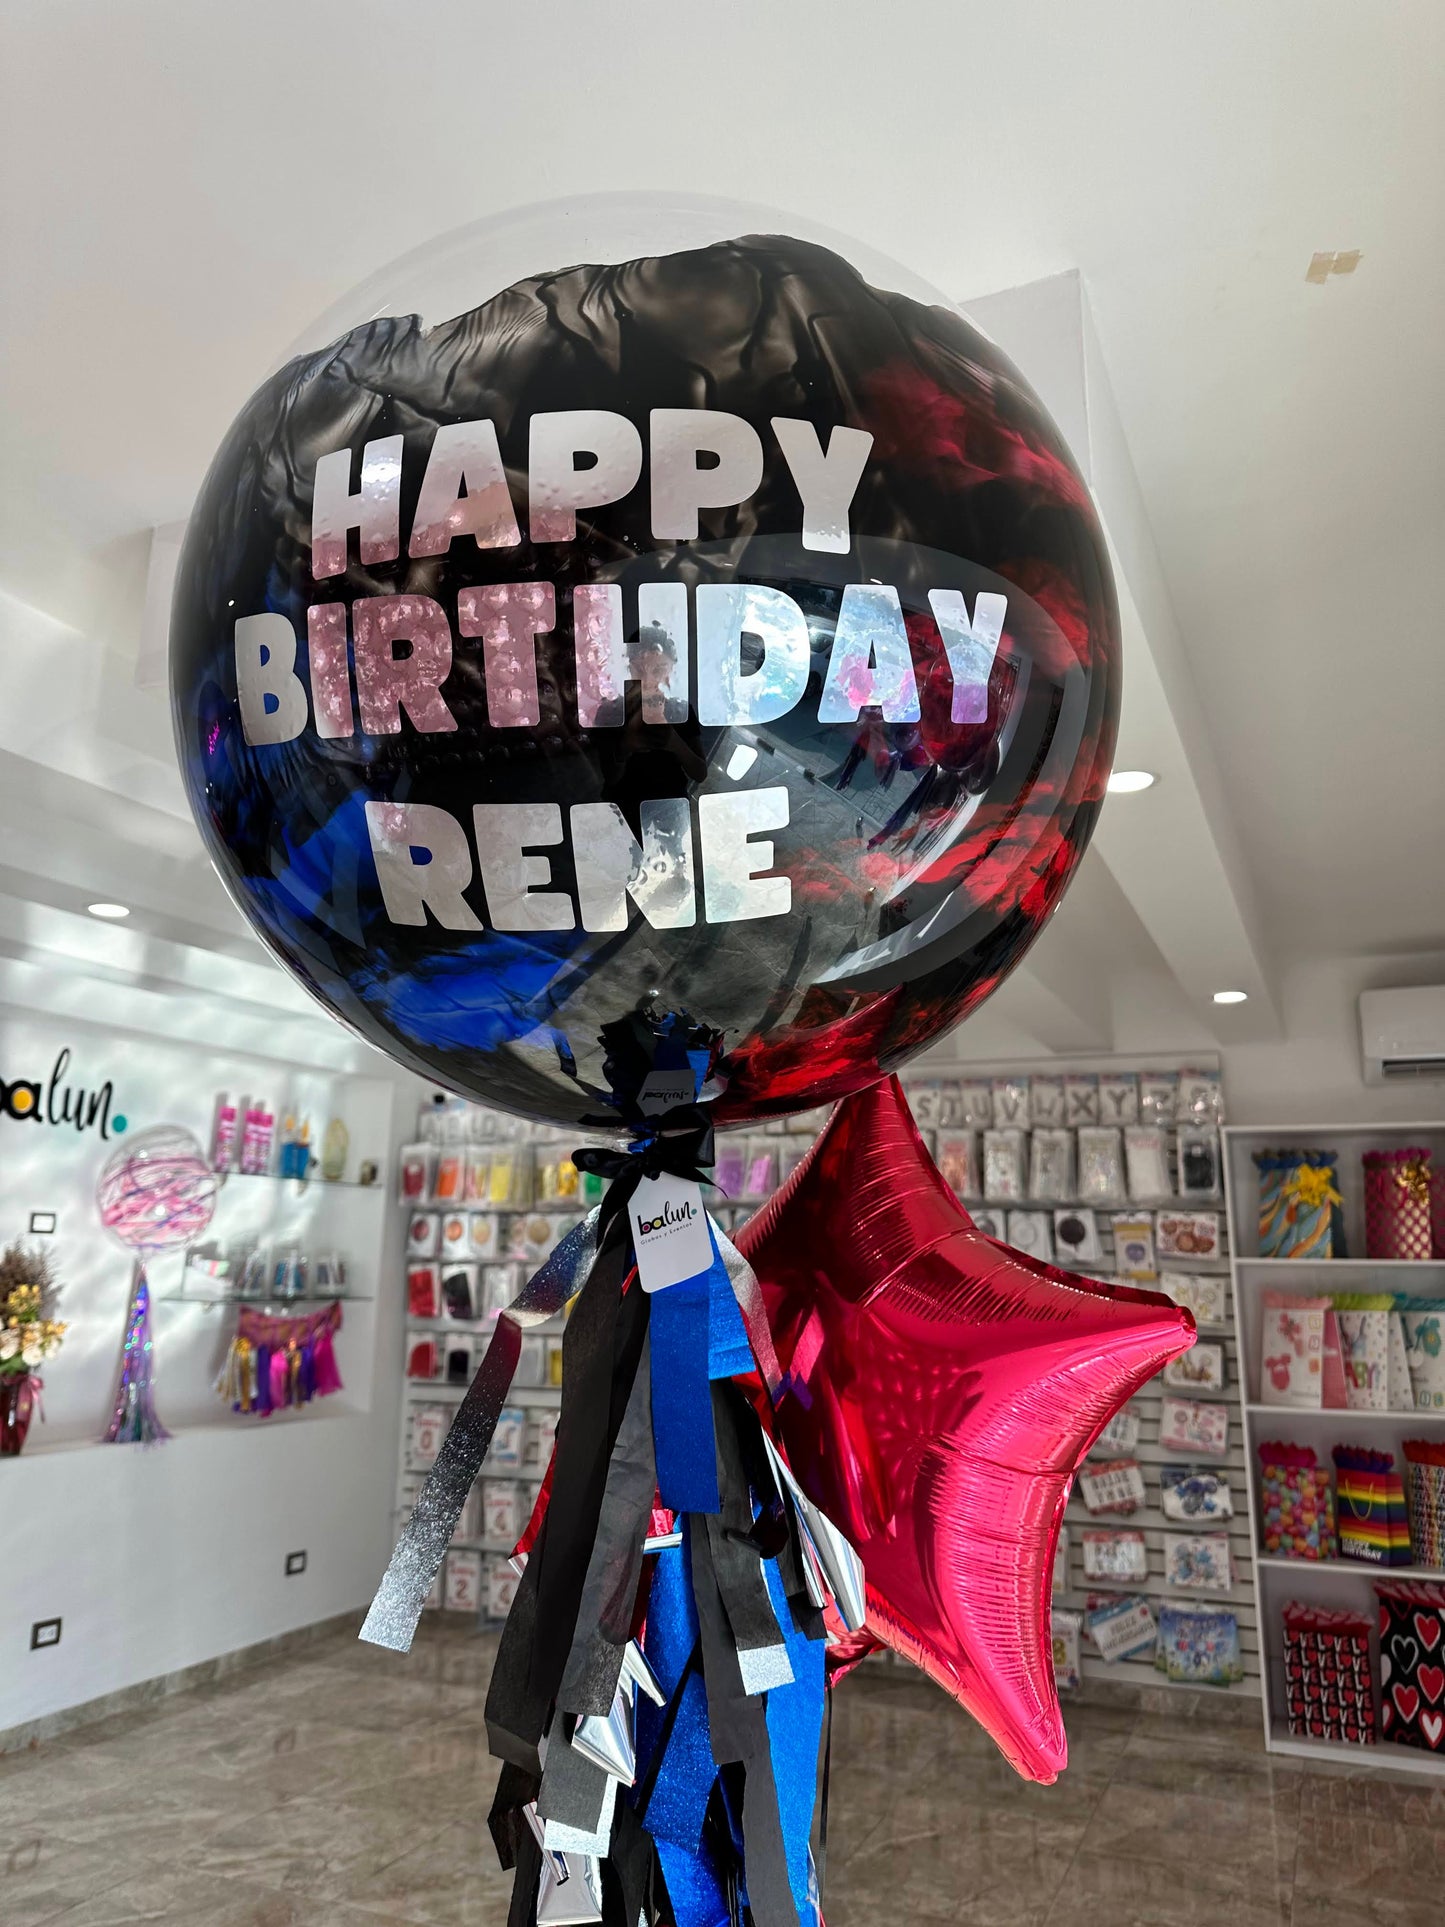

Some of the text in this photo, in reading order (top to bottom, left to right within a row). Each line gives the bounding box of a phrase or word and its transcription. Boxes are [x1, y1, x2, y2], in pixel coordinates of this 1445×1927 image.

[312, 408, 874, 581] HAPPY
[234, 581, 1008, 746] BIRTHDAY
[364, 744, 793, 933] RENÉ
